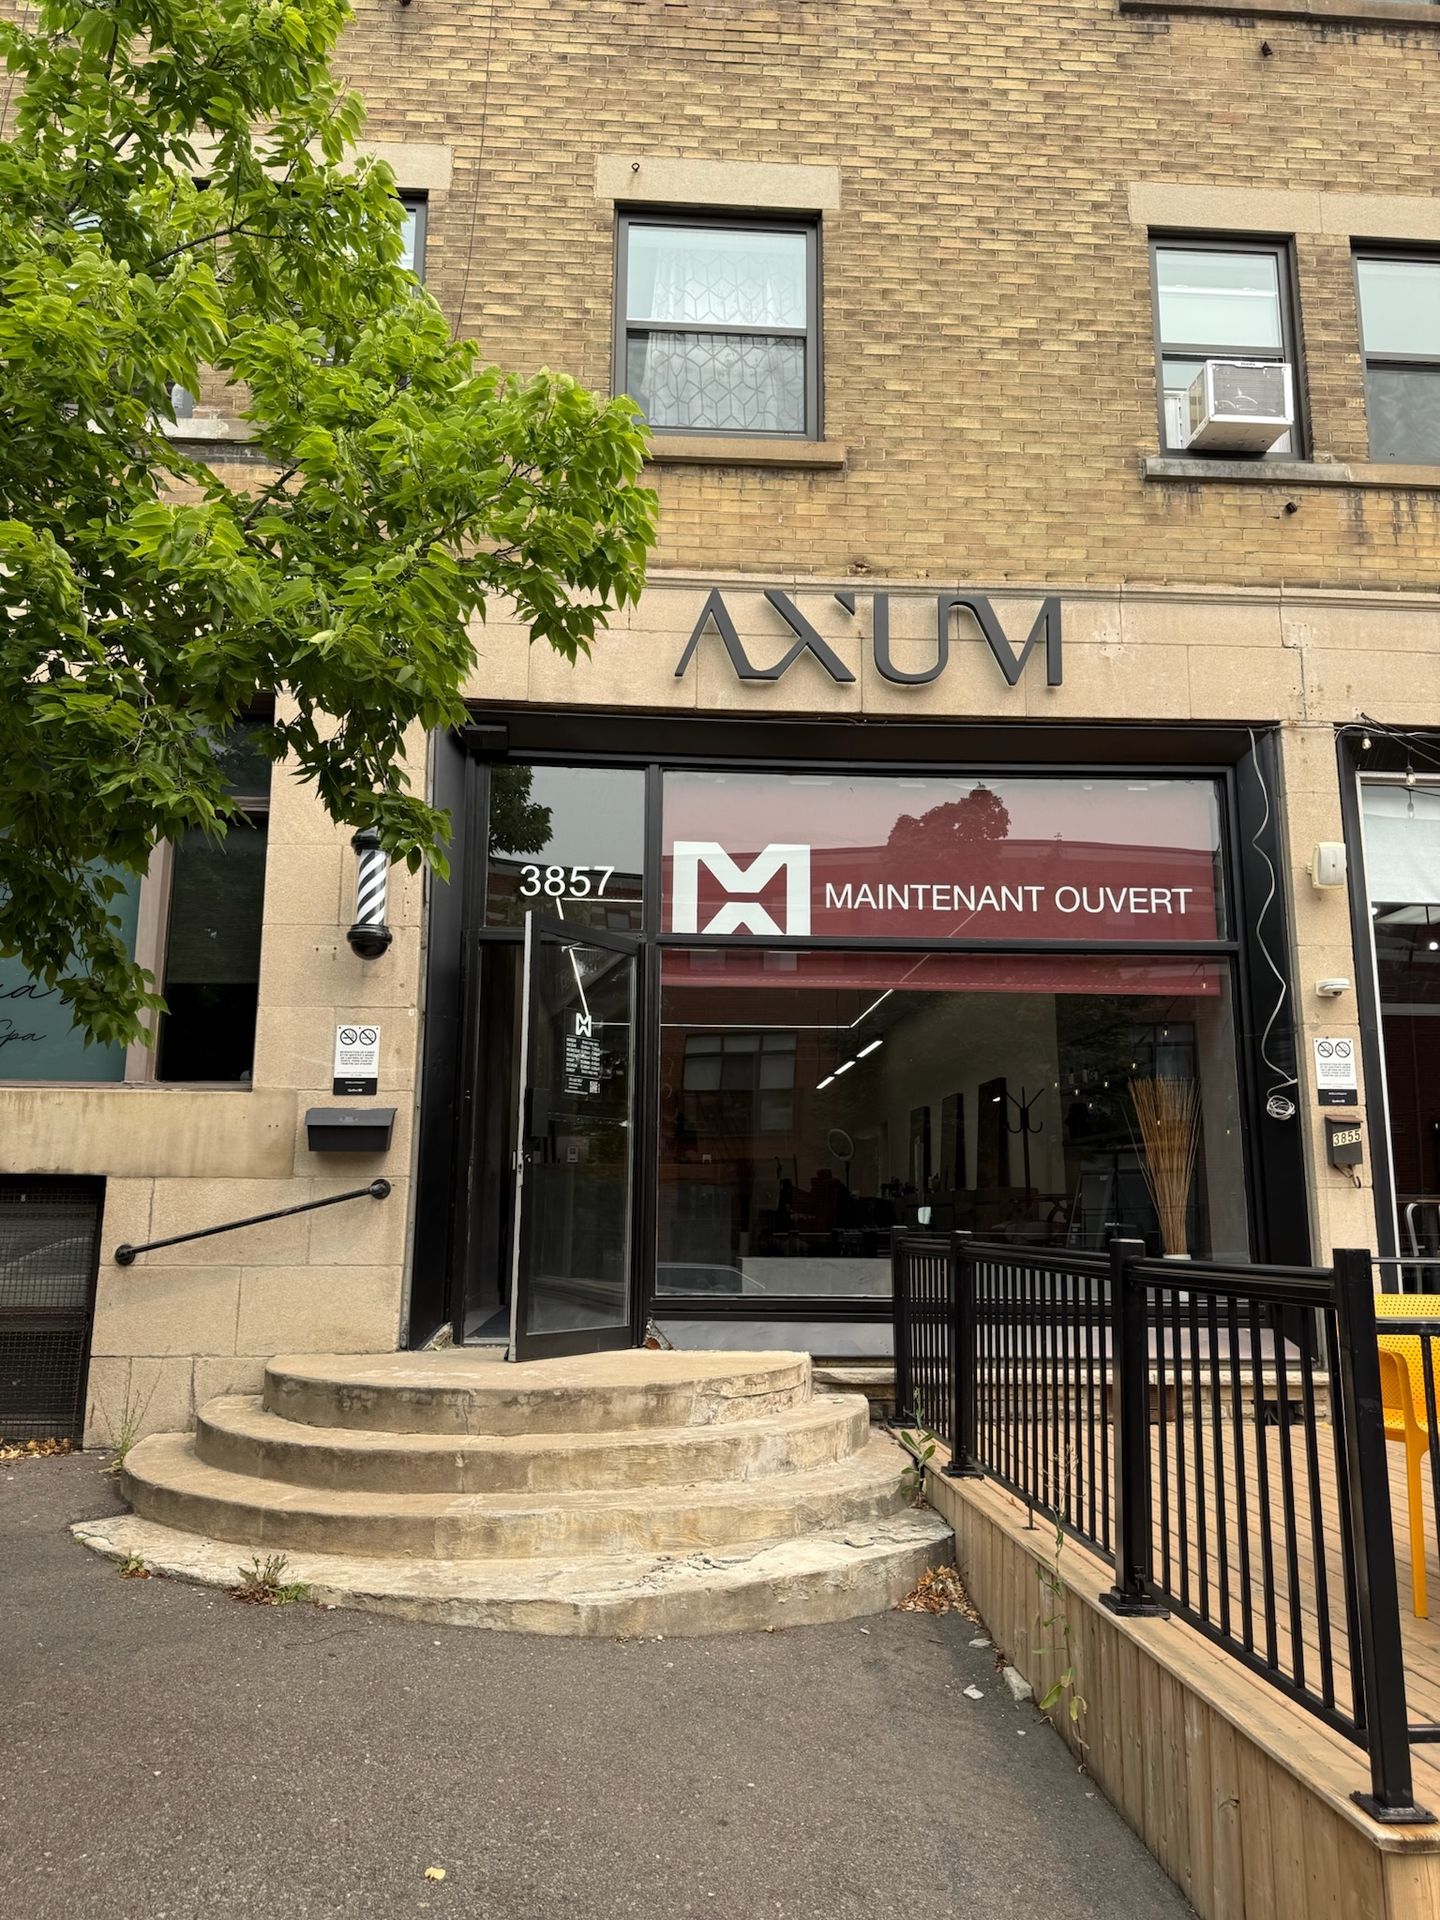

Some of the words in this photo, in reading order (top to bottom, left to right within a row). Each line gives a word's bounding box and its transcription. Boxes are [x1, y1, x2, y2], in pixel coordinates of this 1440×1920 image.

[673, 587, 1063, 687] AXUM
[518, 865, 615, 898] 3857
[825, 883, 1045, 914] MAINTENANT
[1053, 886, 1193, 916] OUVERT
[1332, 1128, 1361, 1146] 3855
